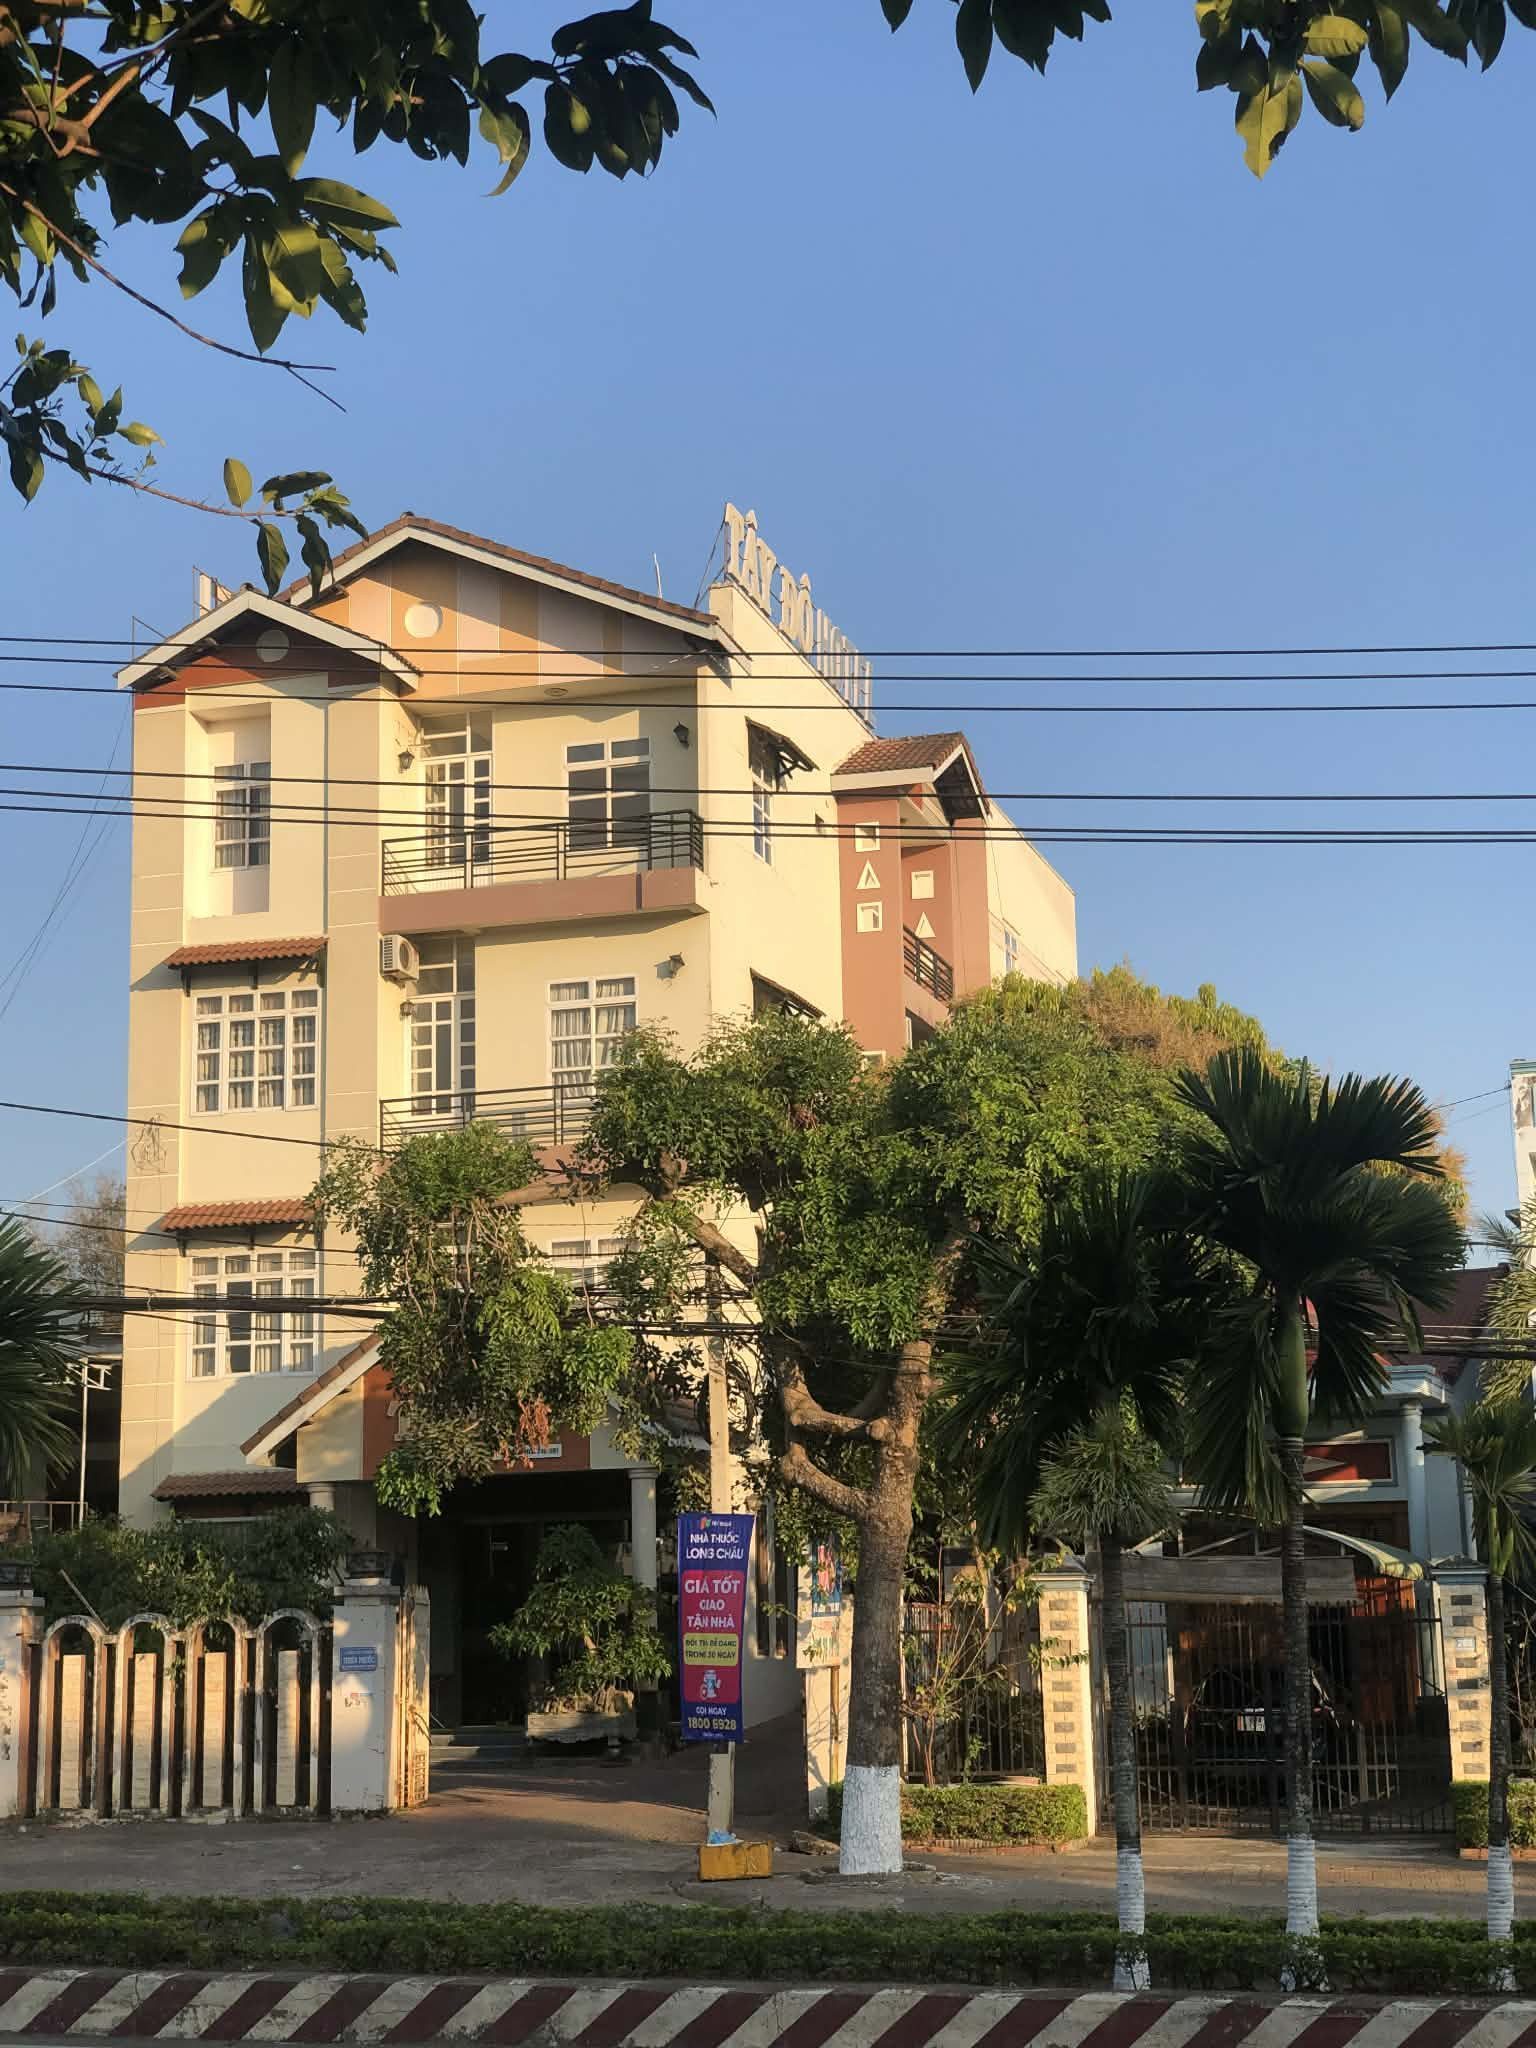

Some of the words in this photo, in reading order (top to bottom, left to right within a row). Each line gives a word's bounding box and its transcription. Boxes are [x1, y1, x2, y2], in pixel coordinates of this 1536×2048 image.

[690, 1531, 709, 1544] NHÀ
[711, 1531, 740, 1544] THUỐC
[716, 1546, 744, 1560] CHÂU
[684, 1576, 710, 1594] GIÁ
[712, 1575, 741, 1594] TỐT
[699, 1599, 726, 1611] GIAO
[687, 1717, 710, 1729] 1800
